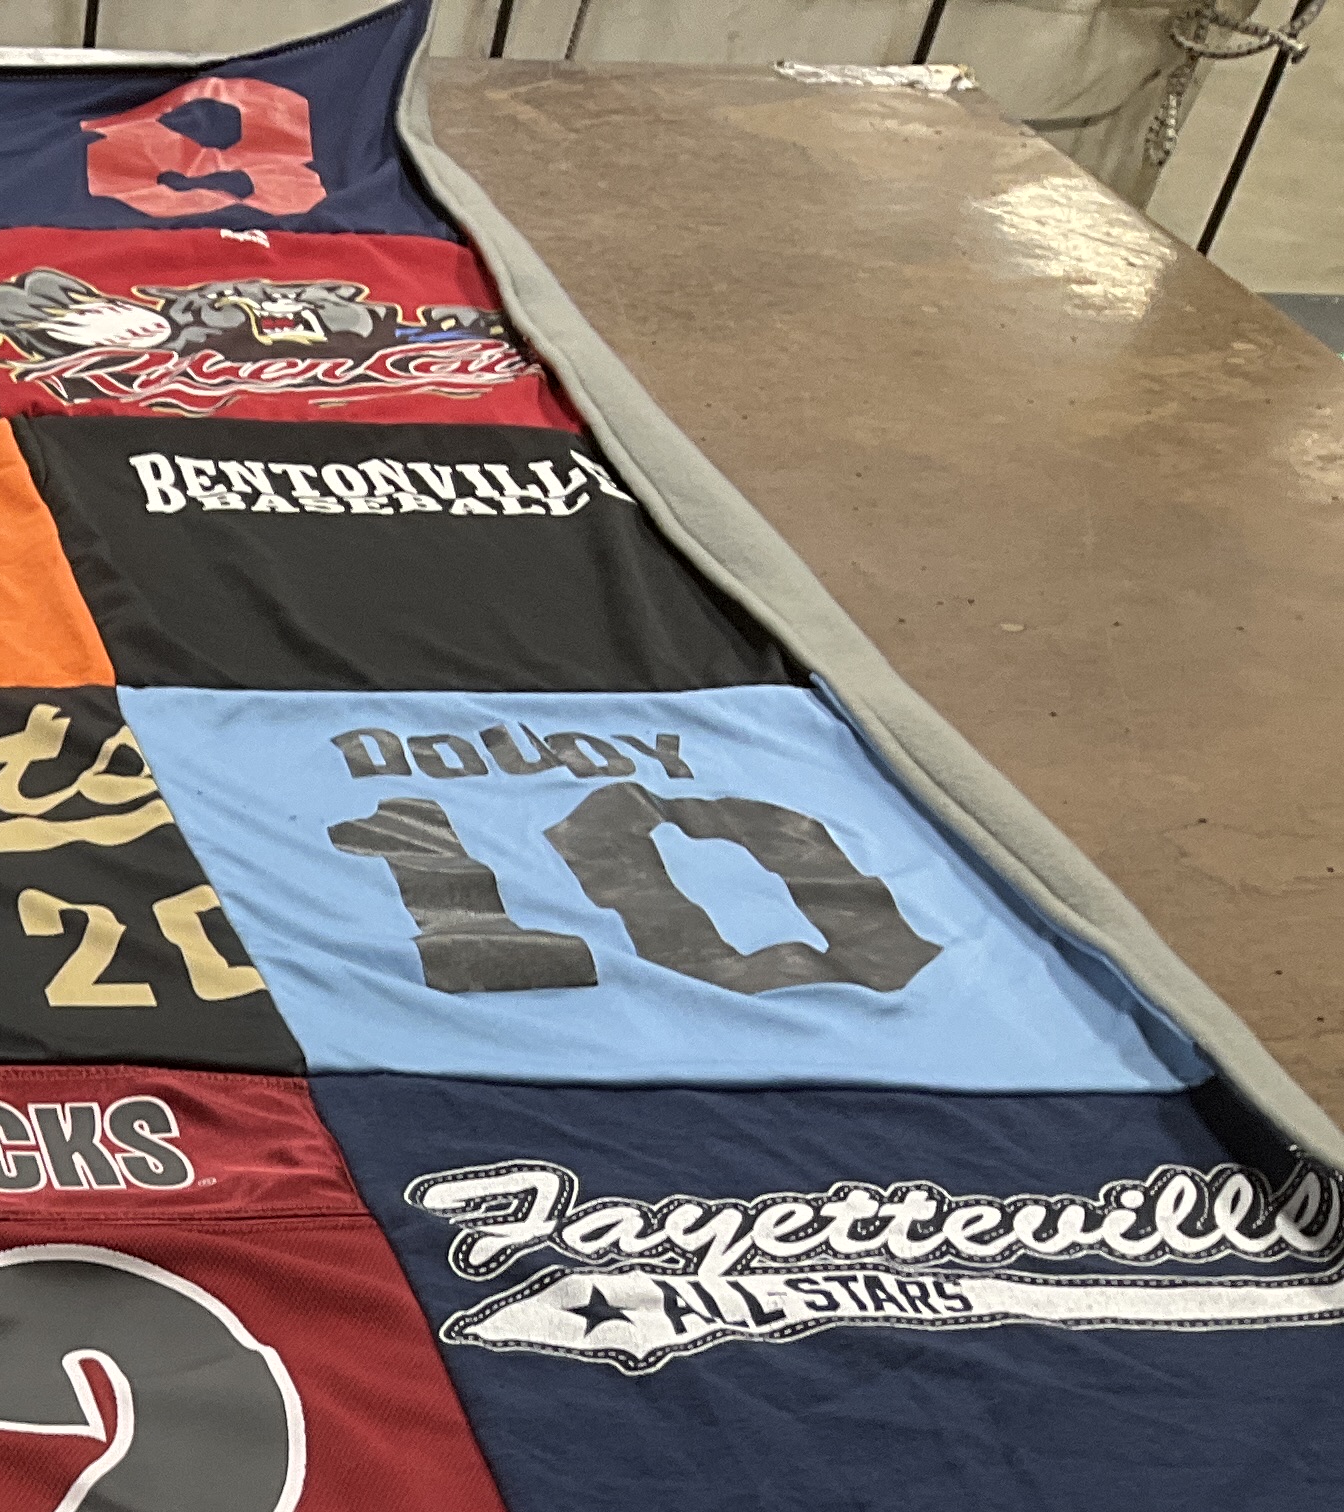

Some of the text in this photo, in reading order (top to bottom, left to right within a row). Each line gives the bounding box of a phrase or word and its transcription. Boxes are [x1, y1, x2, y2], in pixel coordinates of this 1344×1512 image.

[79, 76, 327, 217] 8
[196, 492, 591, 517] BASEBALL
[326, 780, 944, 995] 10
